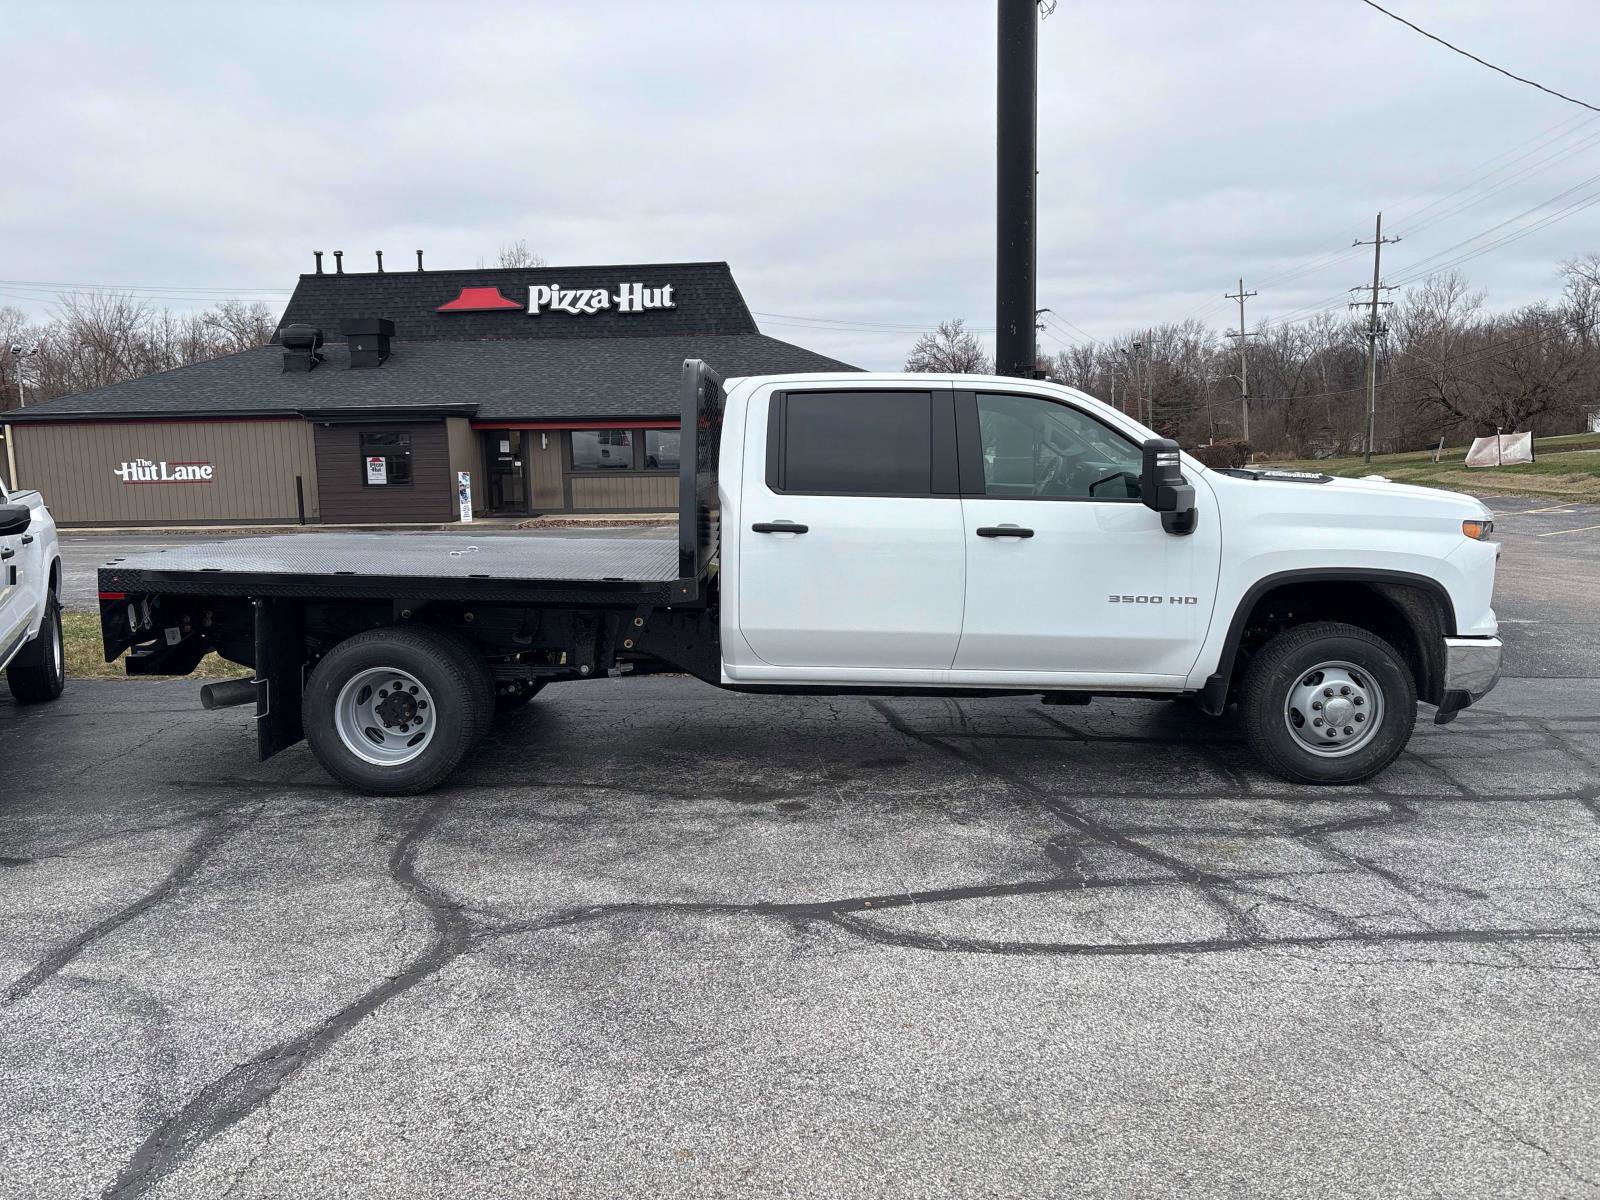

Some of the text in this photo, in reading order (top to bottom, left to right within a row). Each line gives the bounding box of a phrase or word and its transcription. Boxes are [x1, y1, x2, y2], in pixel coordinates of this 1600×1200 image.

[528, 283, 674, 314] Pizza Hut
[136, 459, 153, 467] The
[114, 461, 213, 481] Hut Lane
[1108, 595, 1198, 605] 3500 HD
